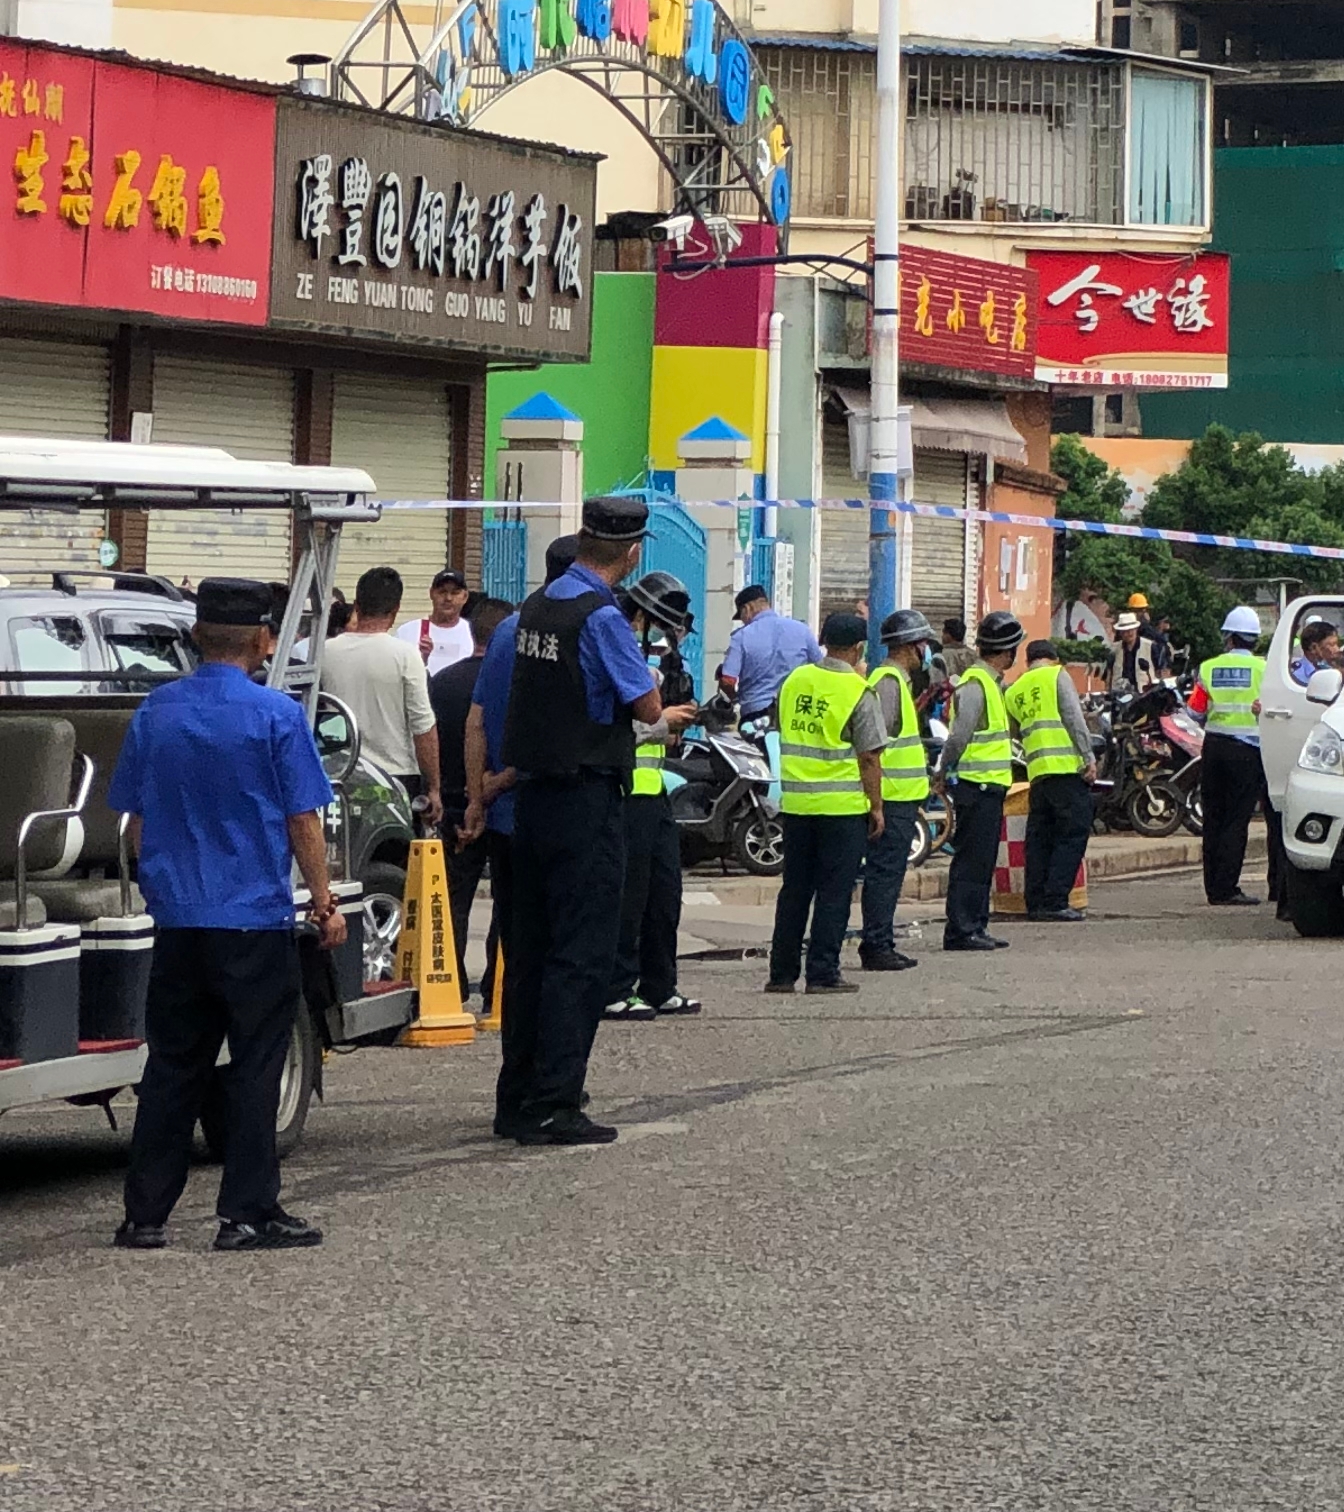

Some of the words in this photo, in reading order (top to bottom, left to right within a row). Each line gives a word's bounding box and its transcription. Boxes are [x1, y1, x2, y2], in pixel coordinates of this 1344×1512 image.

[15, 129, 227, 245] 生态石锅鱼
[296, 273, 313, 300] ZE
[327, 276, 359, 304] FENG
[364, 280, 397, 309] YUAN
[401, 286, 433, 313] TONG
[445, 291, 469, 318] GUO
[474, 296, 506, 323] YANG
[517, 302, 533, 326] YU
[550, 306, 571, 331] FAN
[1047, 264, 1215, 334] 今世缘
[795, 694, 830, 719] 保安
